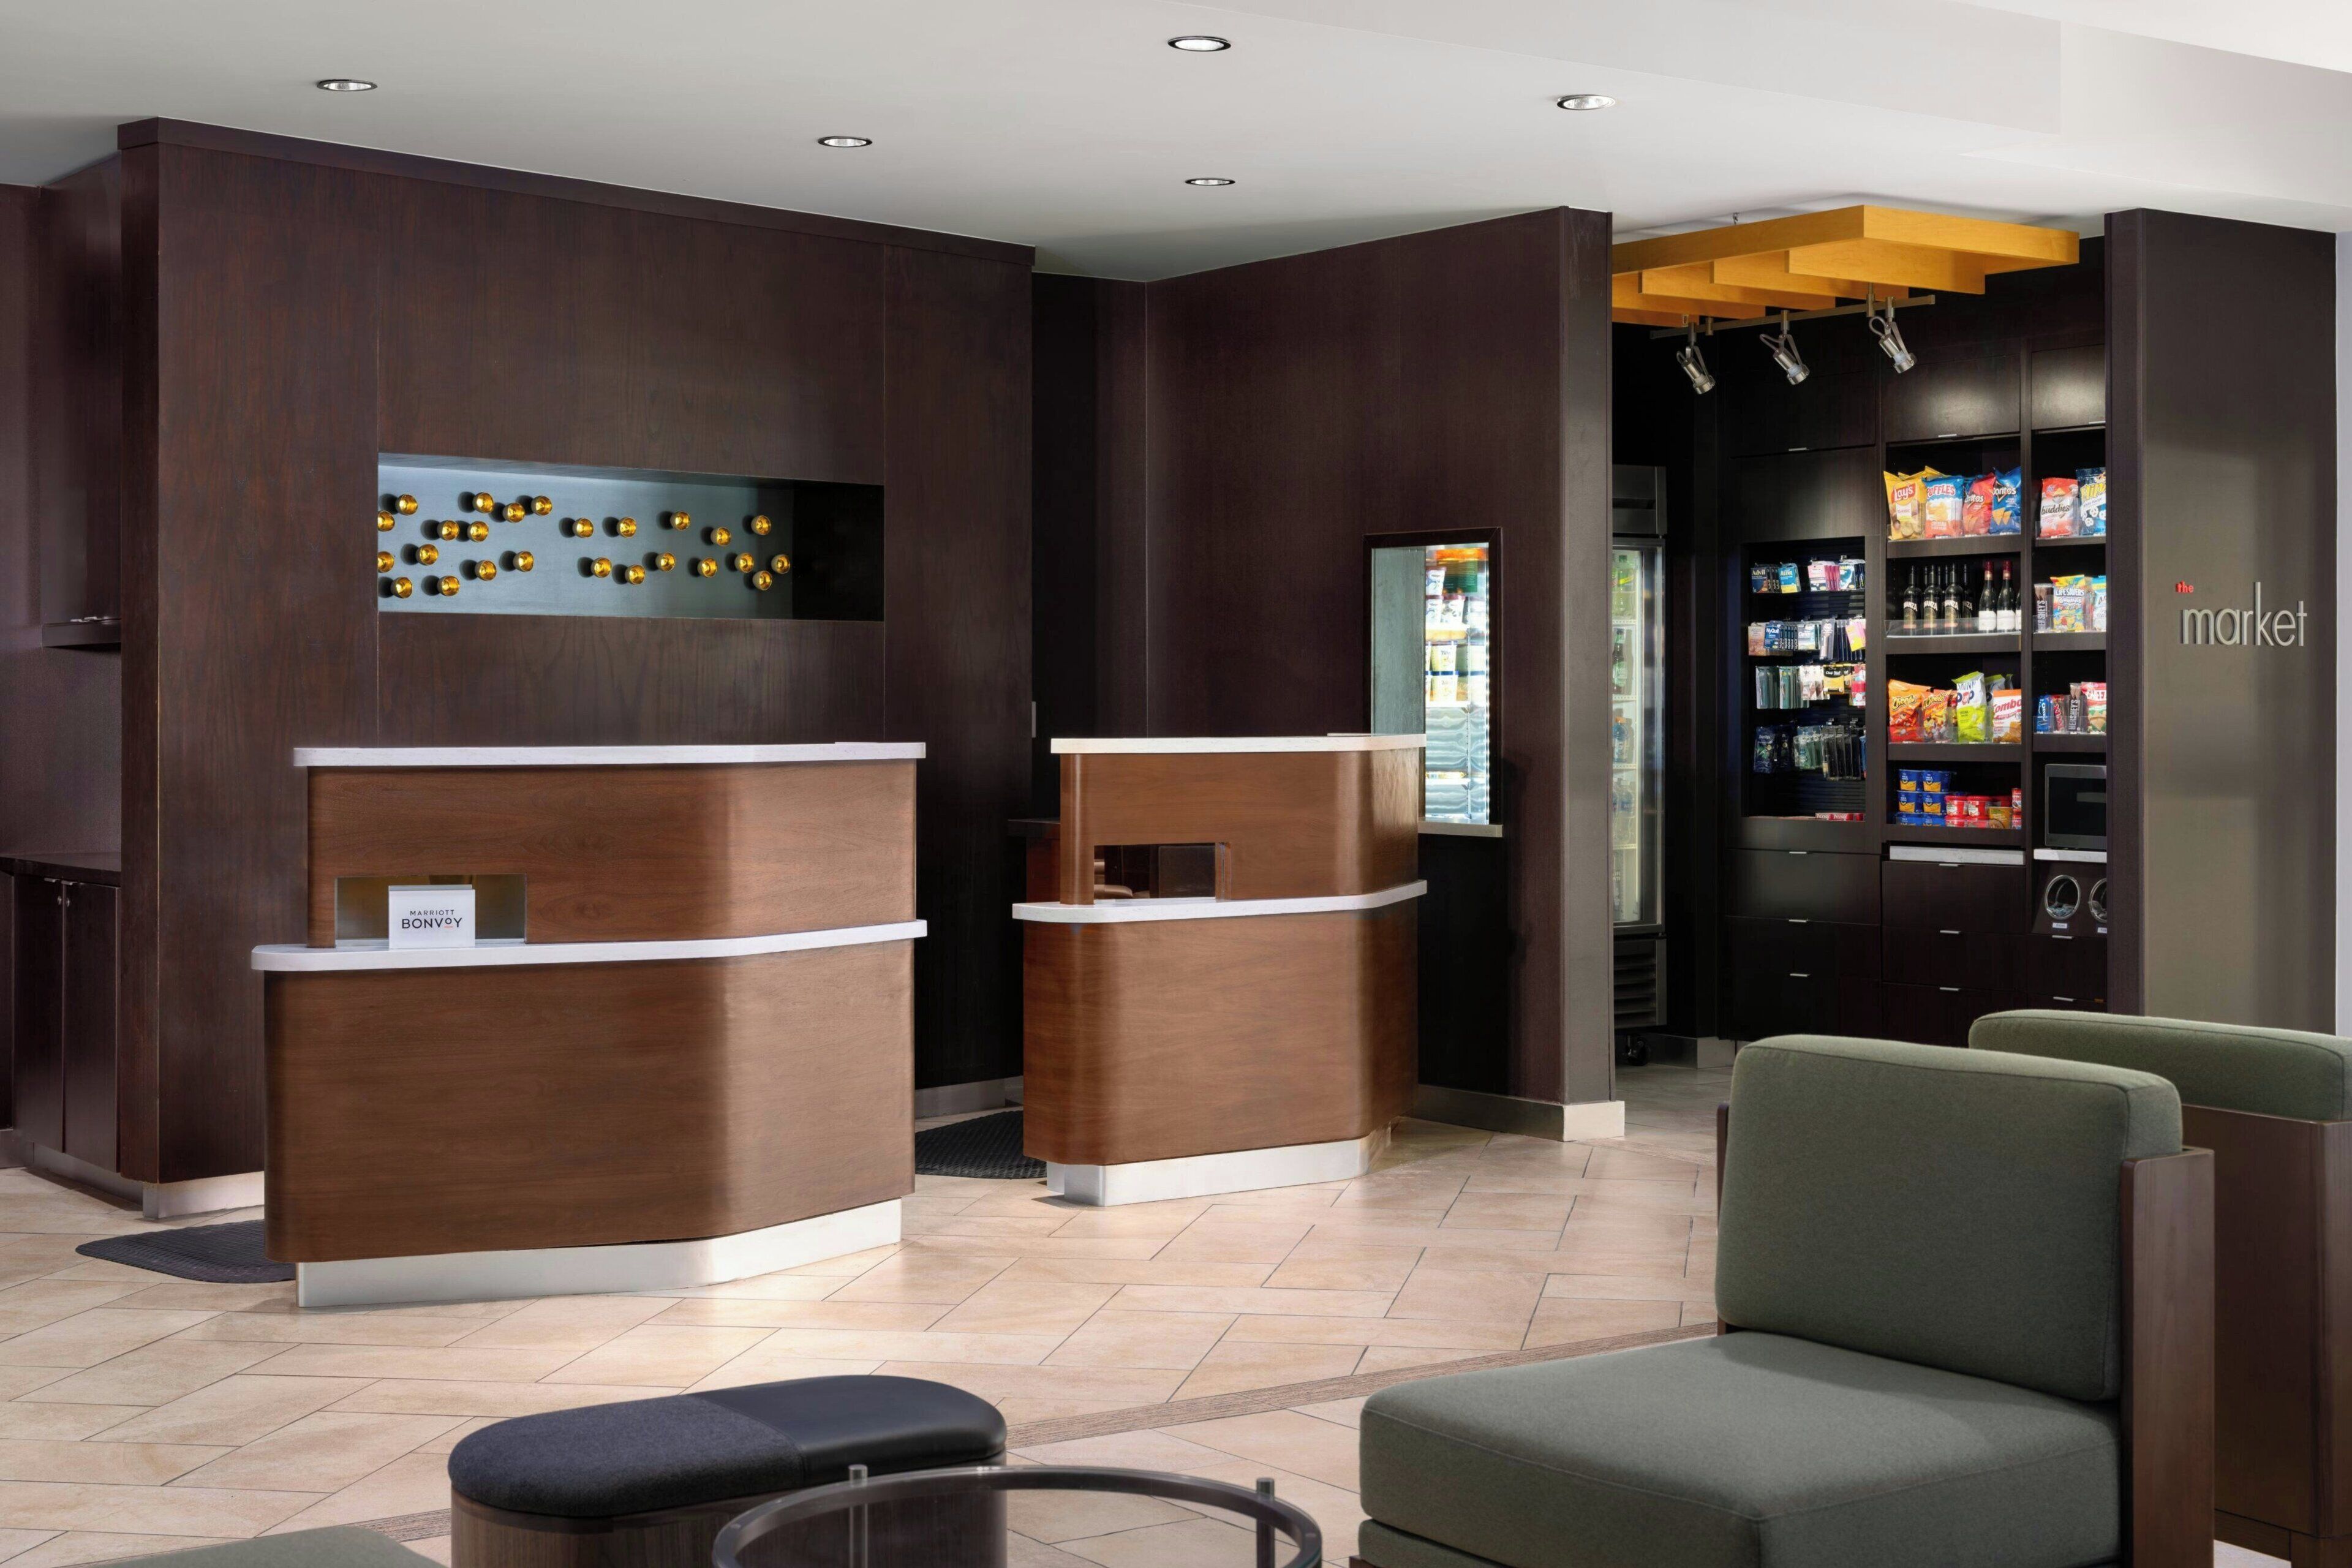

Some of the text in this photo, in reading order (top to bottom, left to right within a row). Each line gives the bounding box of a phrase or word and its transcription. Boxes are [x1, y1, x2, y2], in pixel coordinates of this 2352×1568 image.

[1894, 486, 1913, 501] Lay's
[2041, 503, 2070, 515] buddies
[2176, 580, 2195, 593] the
[2181, 581, 2308, 647] market
[402, 918, 462, 929] BONVOY
